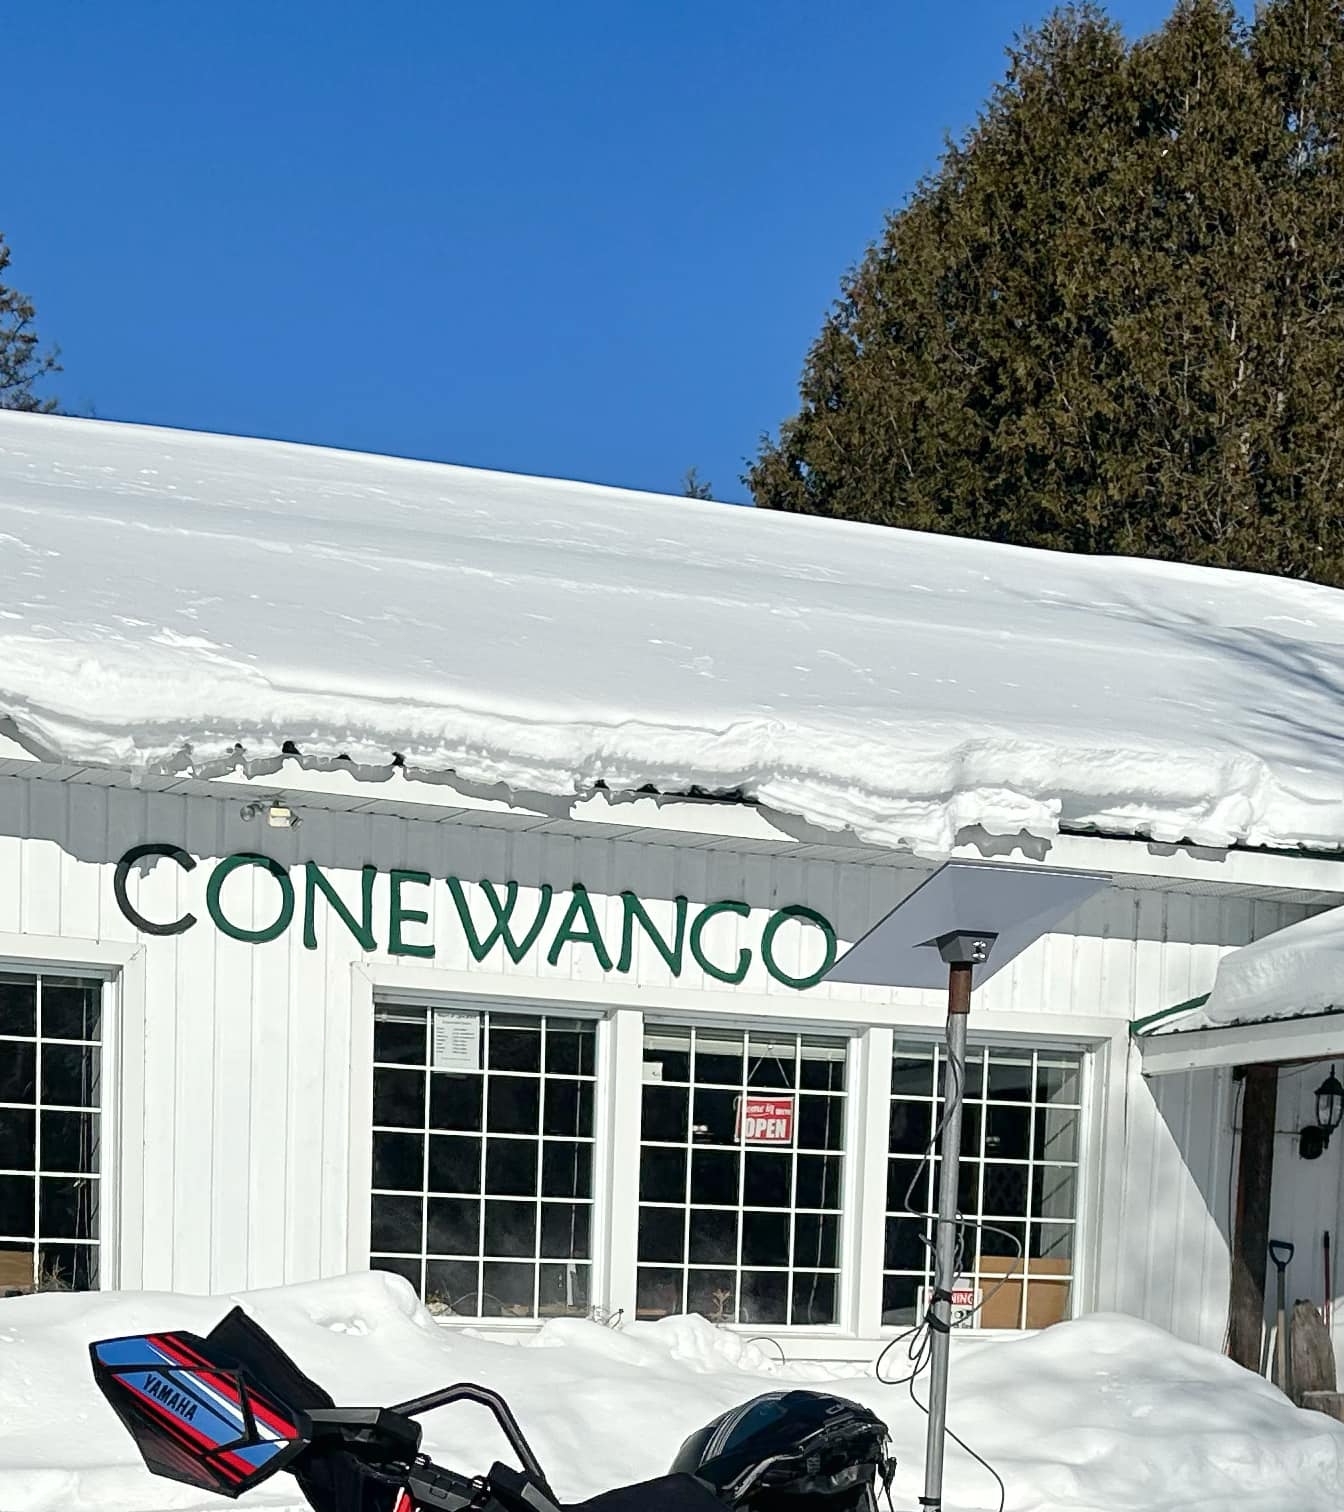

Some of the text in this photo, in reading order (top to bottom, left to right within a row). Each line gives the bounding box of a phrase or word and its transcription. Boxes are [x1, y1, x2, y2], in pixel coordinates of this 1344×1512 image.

[113, 843, 838, 990] CONEWANGO
[745, 1117, 787, 1139] OPEN
[143, 1373, 198, 1421] YAMAHA
